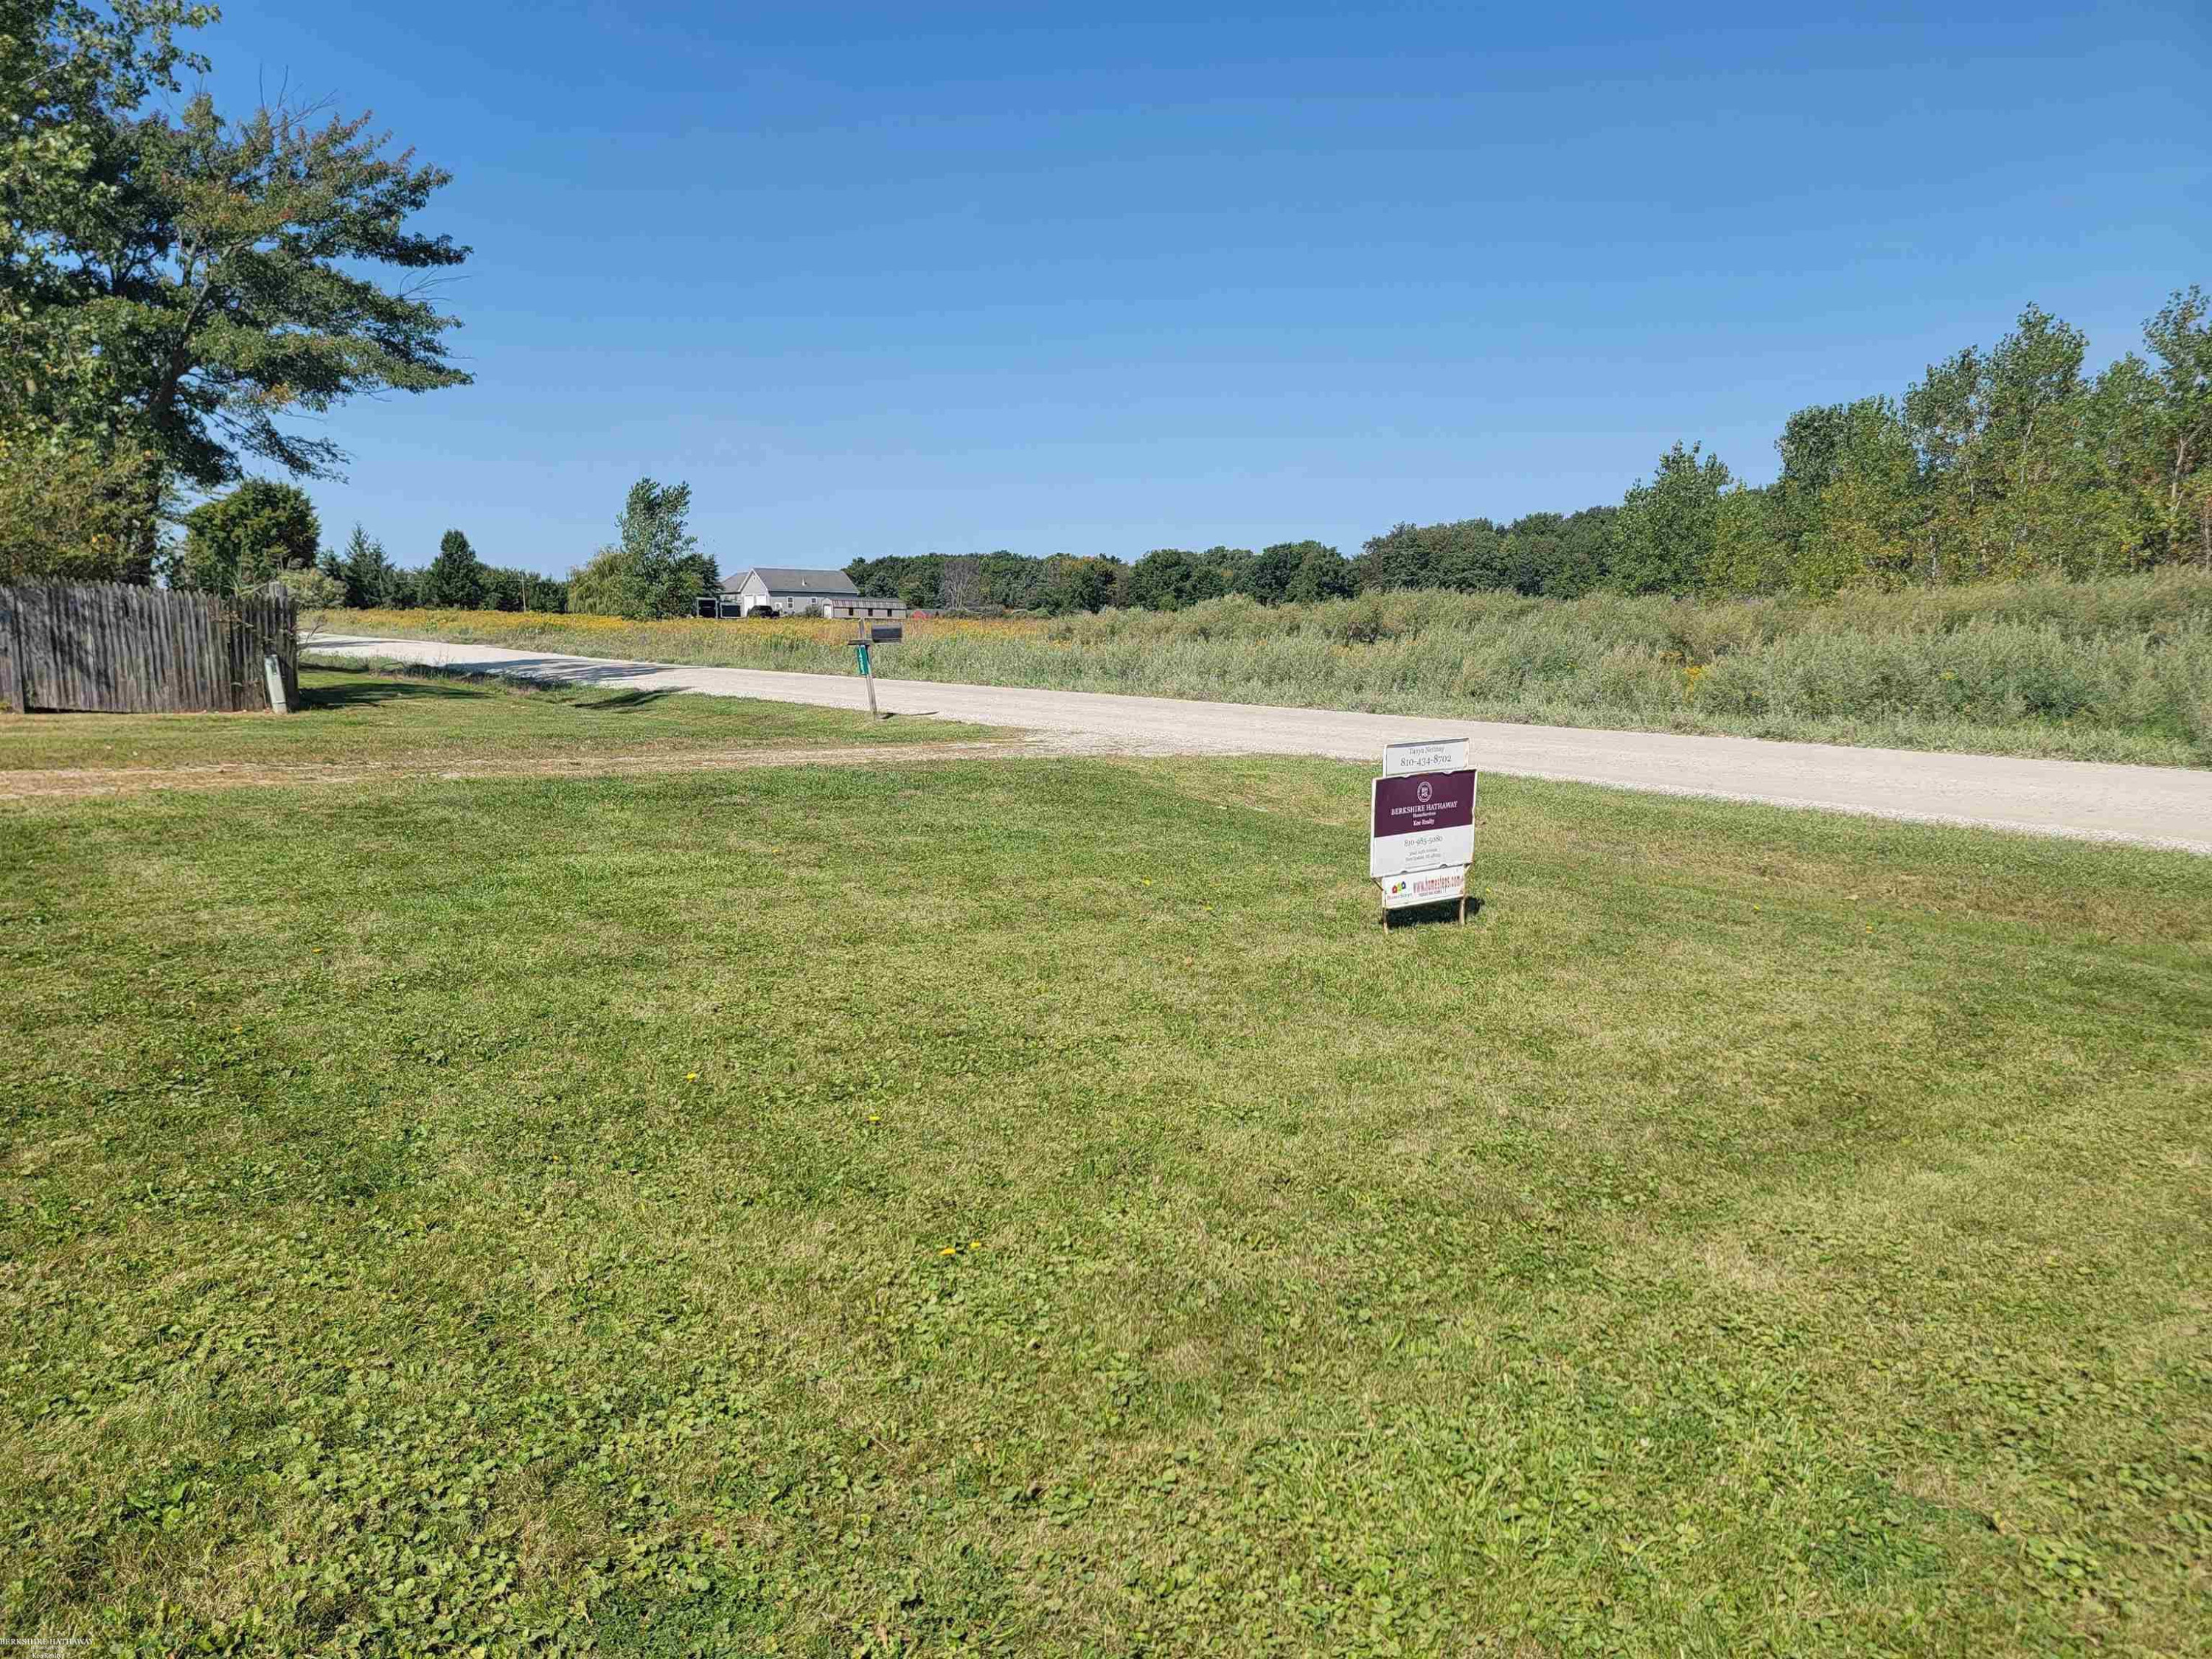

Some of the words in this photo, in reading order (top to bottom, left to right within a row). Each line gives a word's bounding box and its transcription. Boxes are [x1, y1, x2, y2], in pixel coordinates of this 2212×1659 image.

[1400, 754, 1452, 766] 810-434-8702
[1391, 804, 1425, 815] BERKSHIRE
[1426, 801, 1458, 810] HATHAWAY
